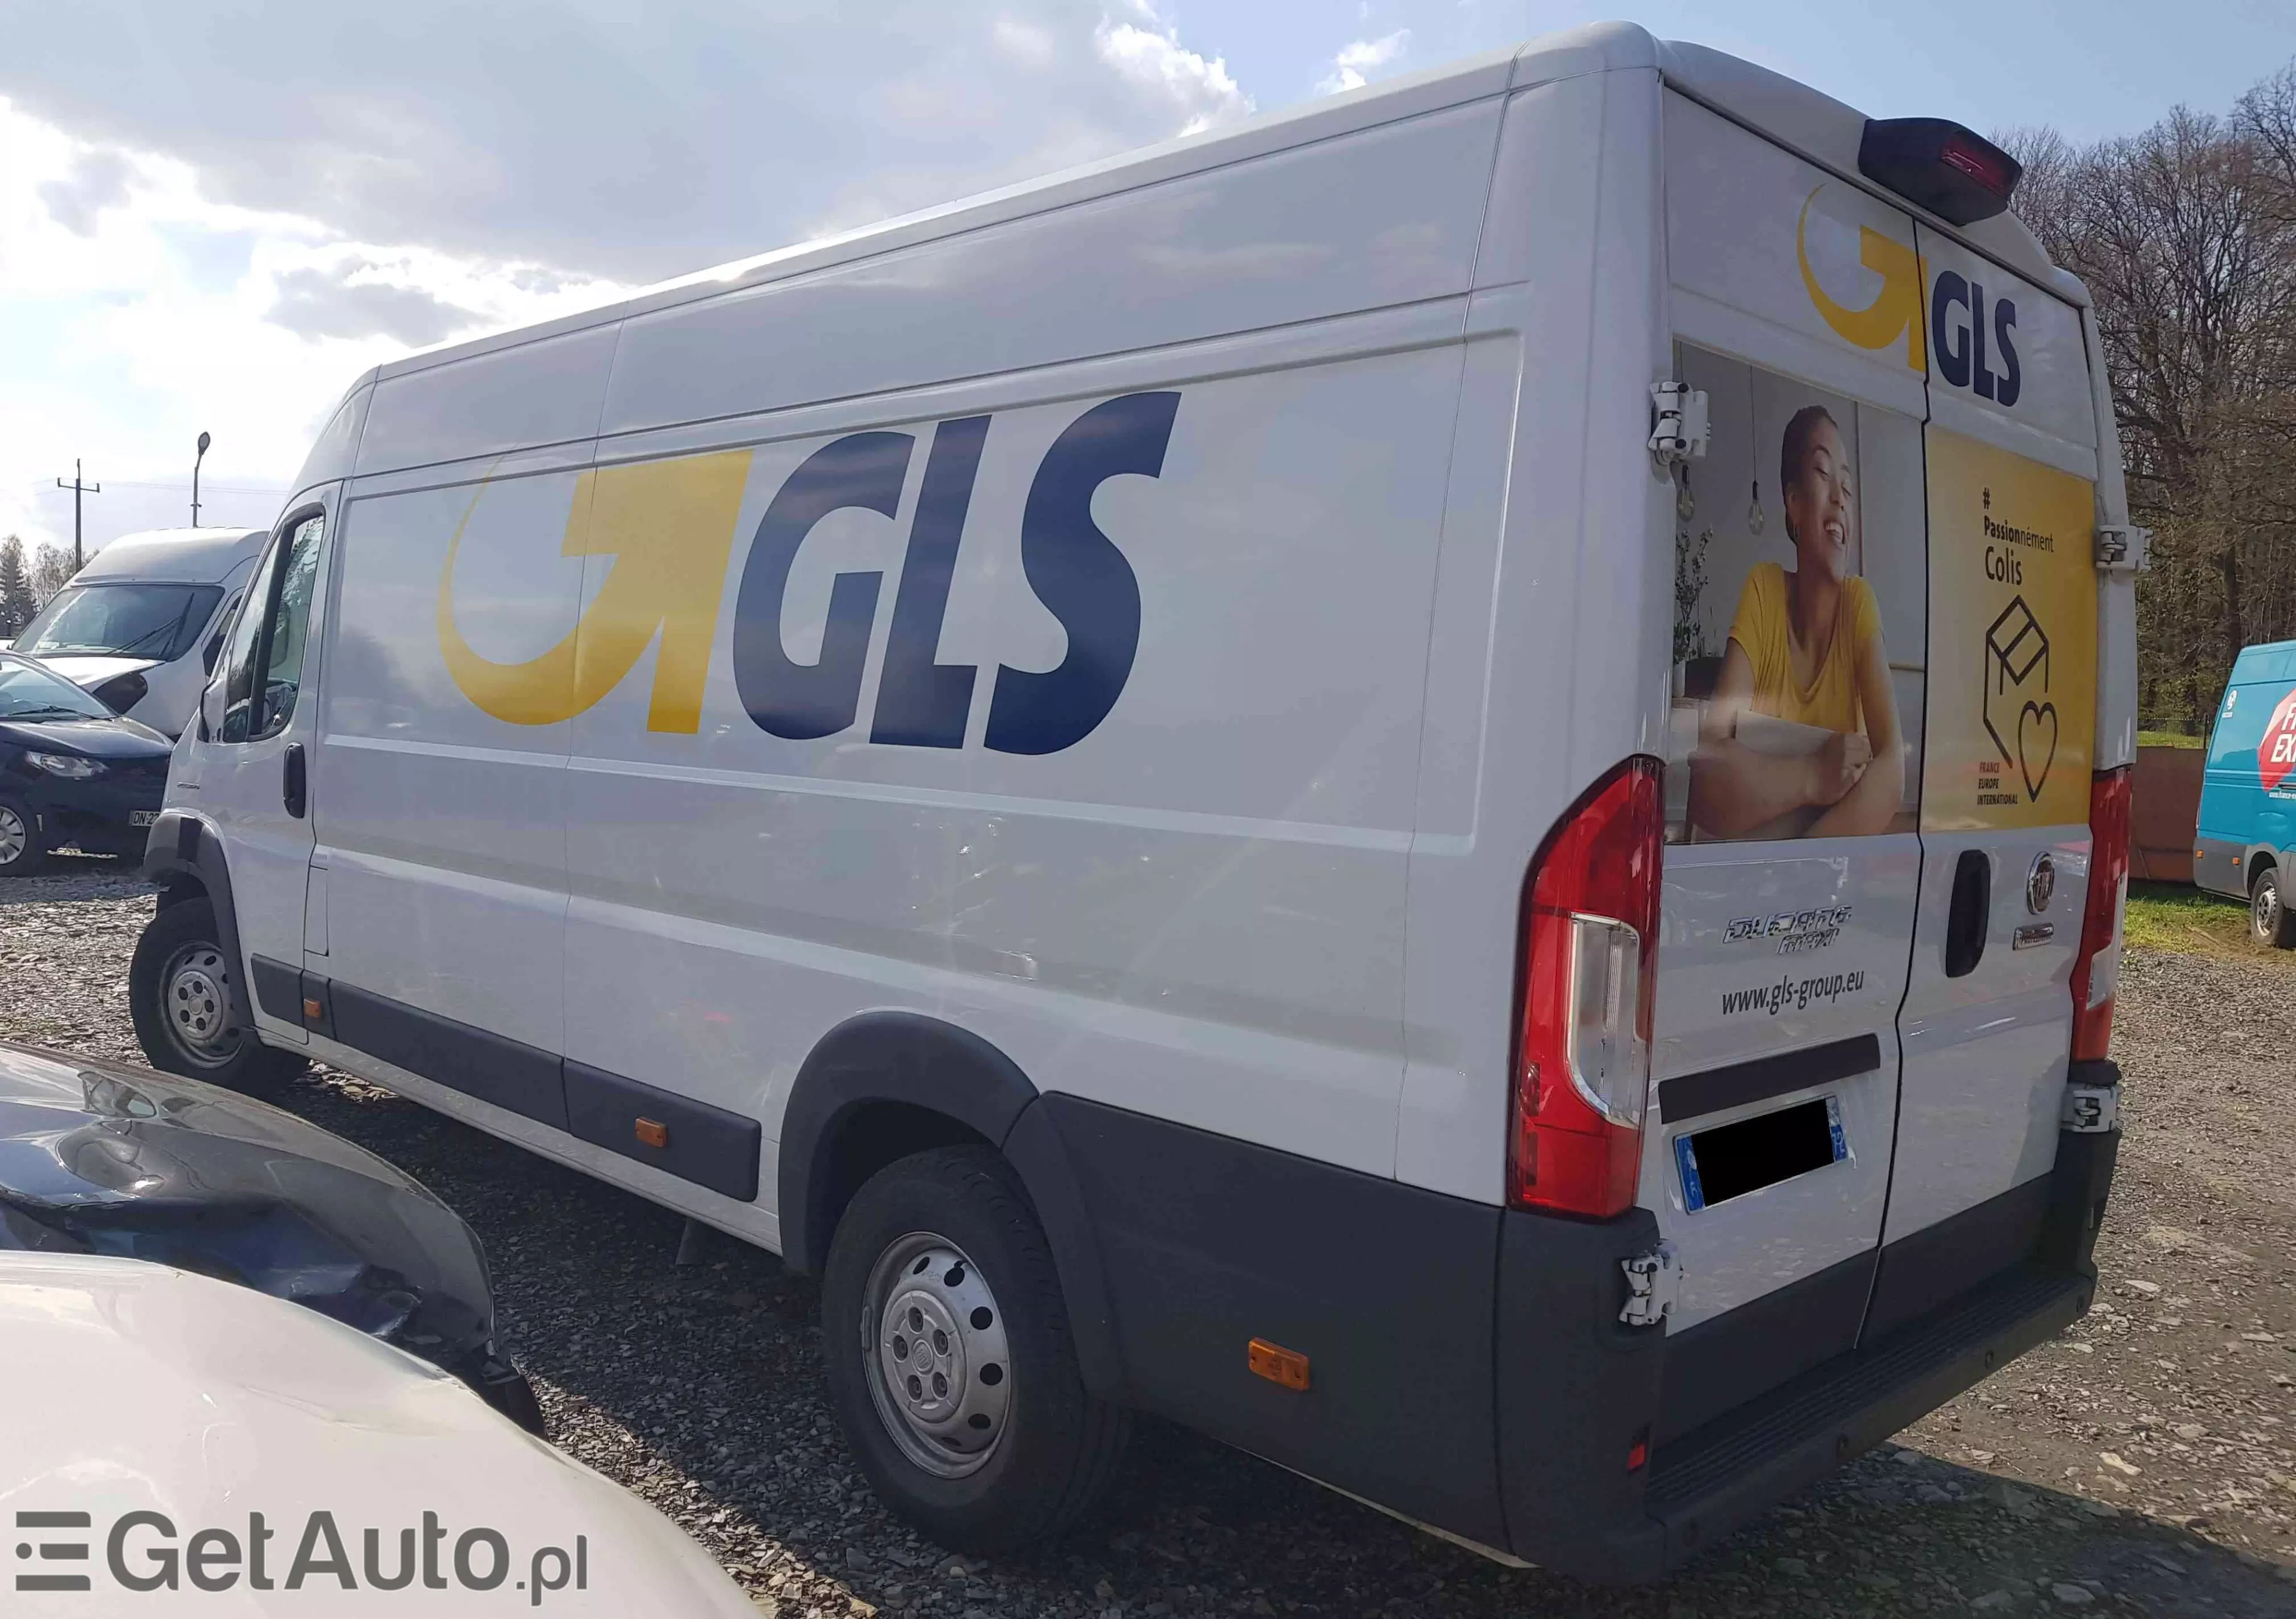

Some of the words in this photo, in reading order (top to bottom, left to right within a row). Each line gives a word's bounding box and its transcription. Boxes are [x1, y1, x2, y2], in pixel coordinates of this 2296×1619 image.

[1932, 270, 2021, 407] GLS
[1983, 487, 1990, 509] #
[1983, 515, 2054, 553] Passionnément
[733, 392, 1182, 755] GLS
[1985, 546, 2022, 585] Colis
[1978, 778, 1999, 789] EUROPE
[1979, 761, 1999, 773] FRANCE
[1977, 793, 2018, 805] INTERNATIONAL
[1722, 970, 1864, 1016] www.gls-group.eu
